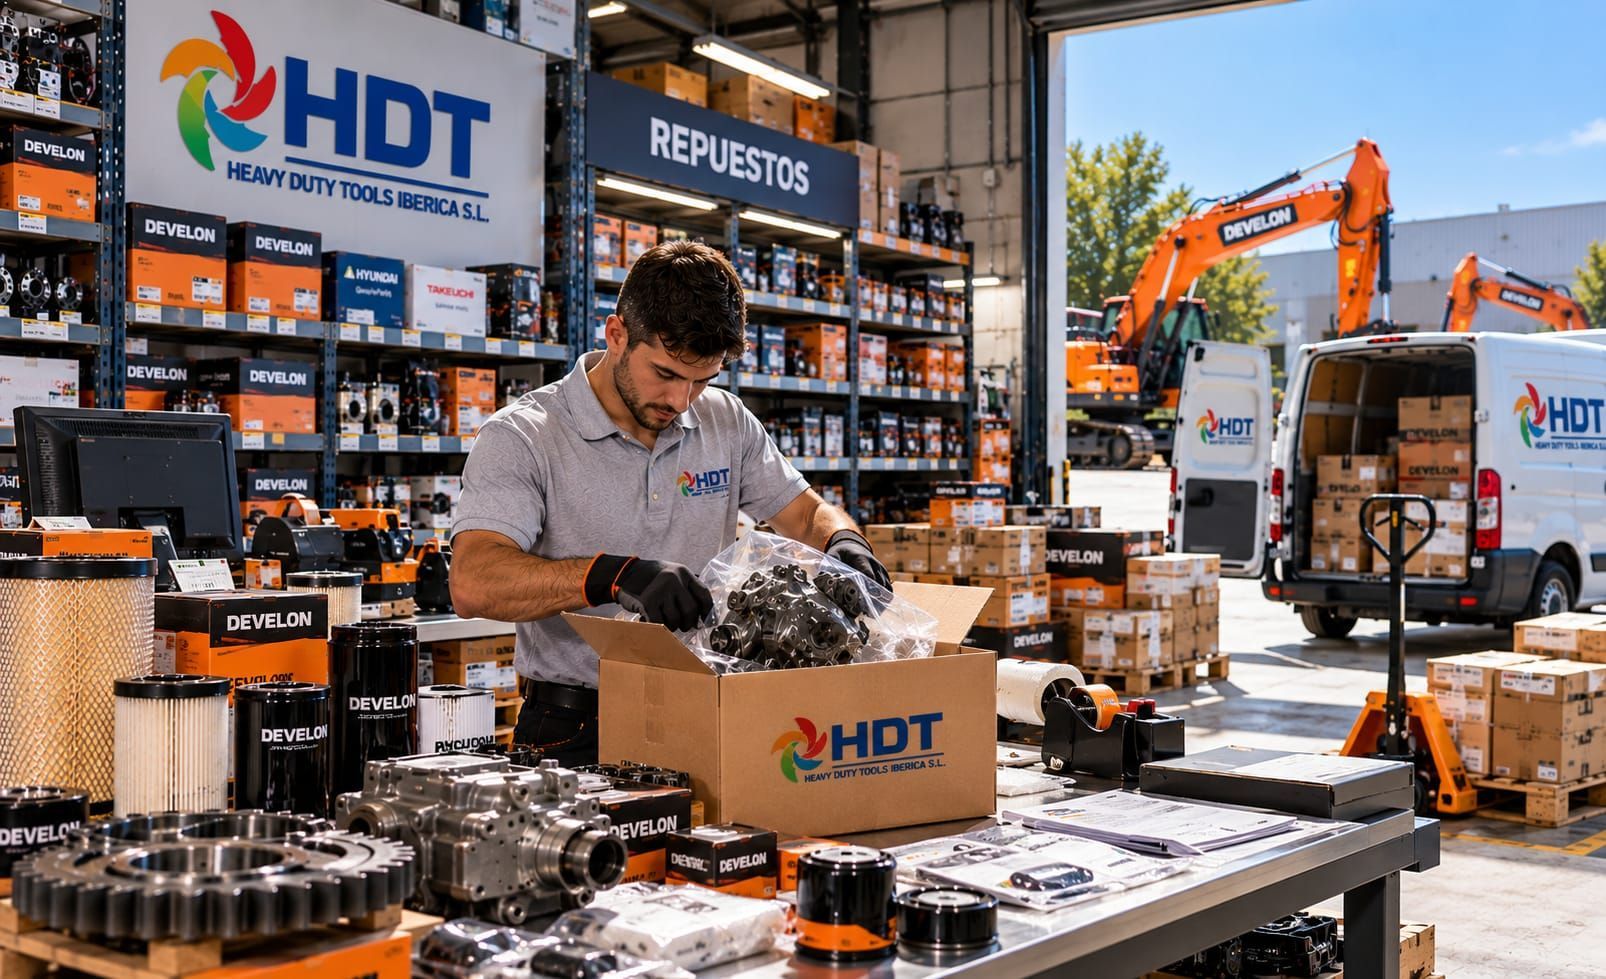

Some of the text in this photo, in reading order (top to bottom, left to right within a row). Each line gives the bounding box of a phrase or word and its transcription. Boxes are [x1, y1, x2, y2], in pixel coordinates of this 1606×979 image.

[284, 56, 491, 179] HDT
[24, 138, 85, 162] DEVELON
[650, 116, 810, 196] REPUESTOS
[227, 160, 490, 223] HEAVY DUTY TOOLS IBERICA S.L.
[145, 218, 216, 243] DEVELON
[1223, 205, 1292, 241] DEVELON
[255, 235, 313, 256] DEVELON
[356, 268, 399, 285] HYUNDAI
[427, 284, 475, 299] TAKEUCHI
[127, 365, 188, 381] DEVELON
[250, 369, 307, 386] DEVELON
[1548, 396, 1605, 433] HDT
[1219, 417, 1254, 436] HDT
[255, 478, 308, 491] DEVELON
[695, 468, 730, 489] HDT
[1045, 549, 1104, 565] DEVELON
[226, 611, 312, 632] DEVELON
[1014, 632, 1053, 648] DEVELON
[349, 693, 416, 711] DEVELON
[261, 724, 328, 742] DEVELON
[831, 712, 943, 761] HDT
[804, 759, 946, 783] HEAVY DUTY TOOLS IBERICA S.L.
[609, 815, 678, 841] DEVELON
[719, 851, 767, 873] DEVELON
